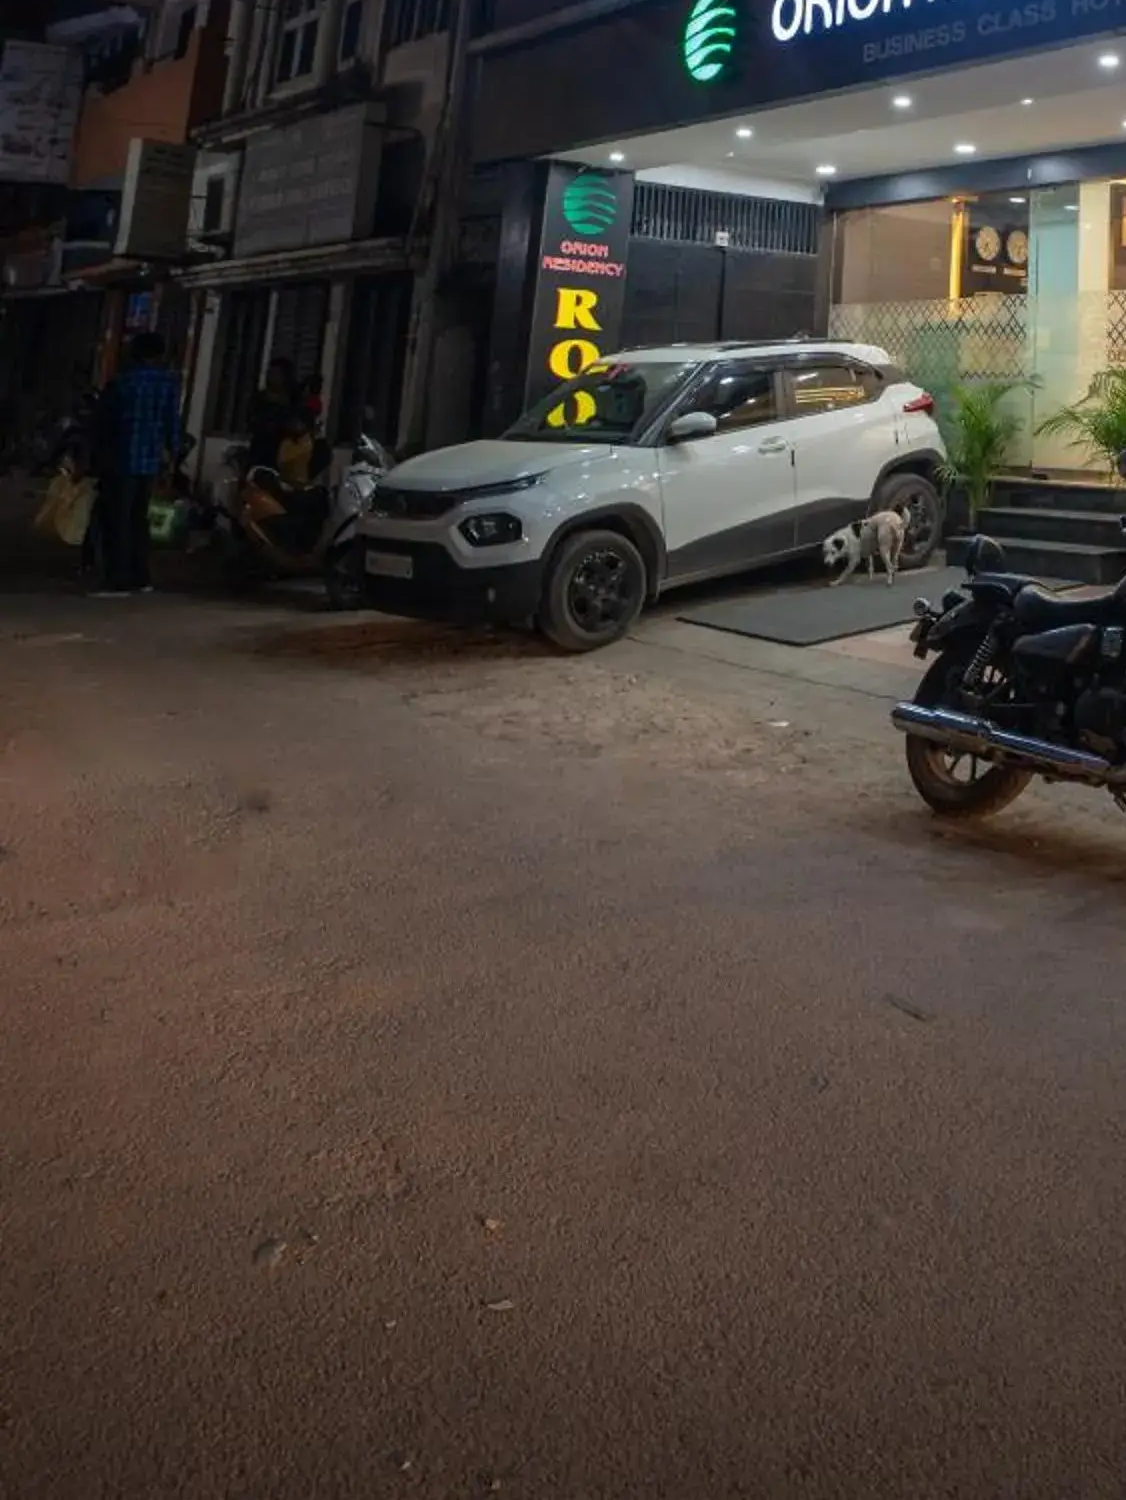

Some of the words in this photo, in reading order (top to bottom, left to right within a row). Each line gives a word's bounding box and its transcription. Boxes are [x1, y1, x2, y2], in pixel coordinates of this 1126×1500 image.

[863, 21, 965, 63] BUSINESS
[561, 240, 608, 257] ORION
[543, 256, 624, 276] RESIDENCY
